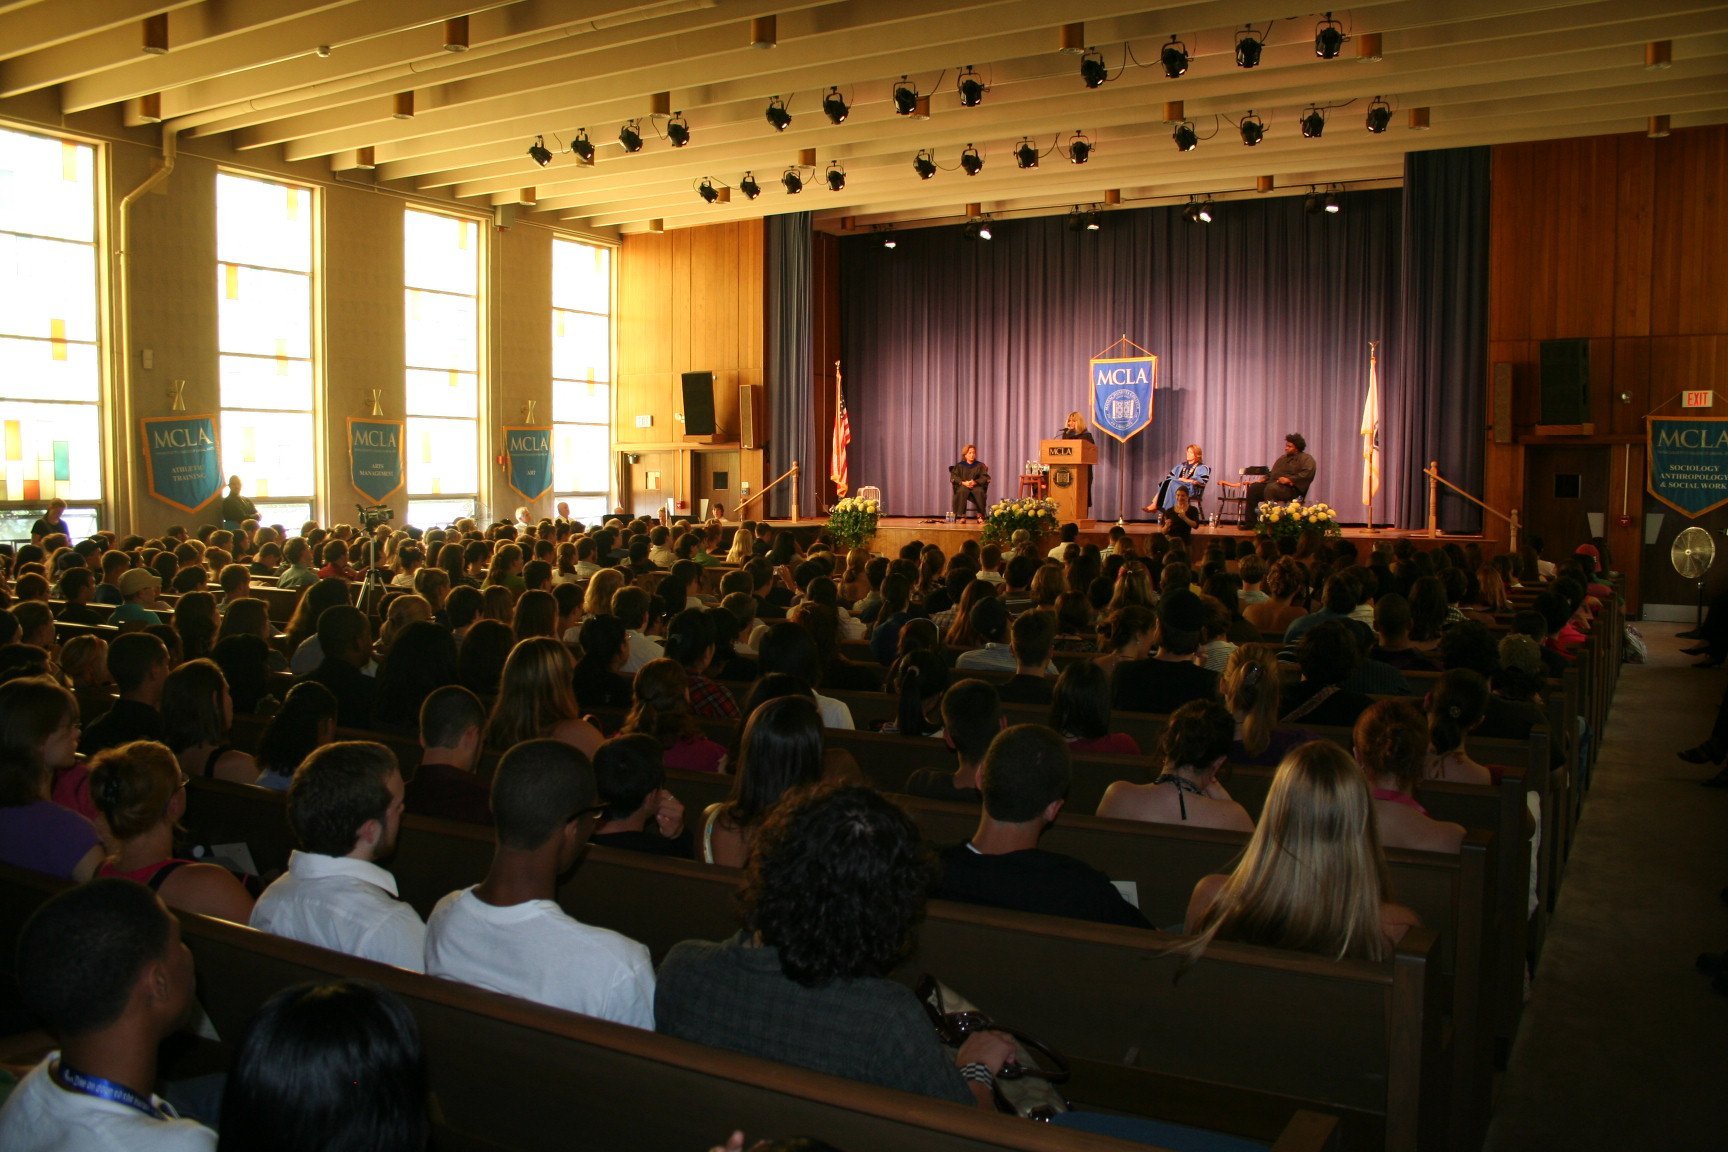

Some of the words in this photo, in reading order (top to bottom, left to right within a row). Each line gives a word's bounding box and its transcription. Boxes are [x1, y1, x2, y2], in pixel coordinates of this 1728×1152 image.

[1096, 368, 1149, 385] MCLA
[1687, 392, 1709, 407] EXIT
[154, 427, 213, 448] MCLA
[354, 430, 396, 447] MCLA
[510, 436, 548, 451] MCLA
[1657, 429, 1728, 448] MCLA
[171, 465, 204, 473] ATHLETIC
[1670, 464, 1719, 472] SOCIOLOGY
[173, 473, 206, 481] TRAINING
[1660, 473, 1728, 481] ANTHROPOLOGY
[1668, 481, 1700, 489] SOCIAL
[1700, 482, 1728, 490] WORK
